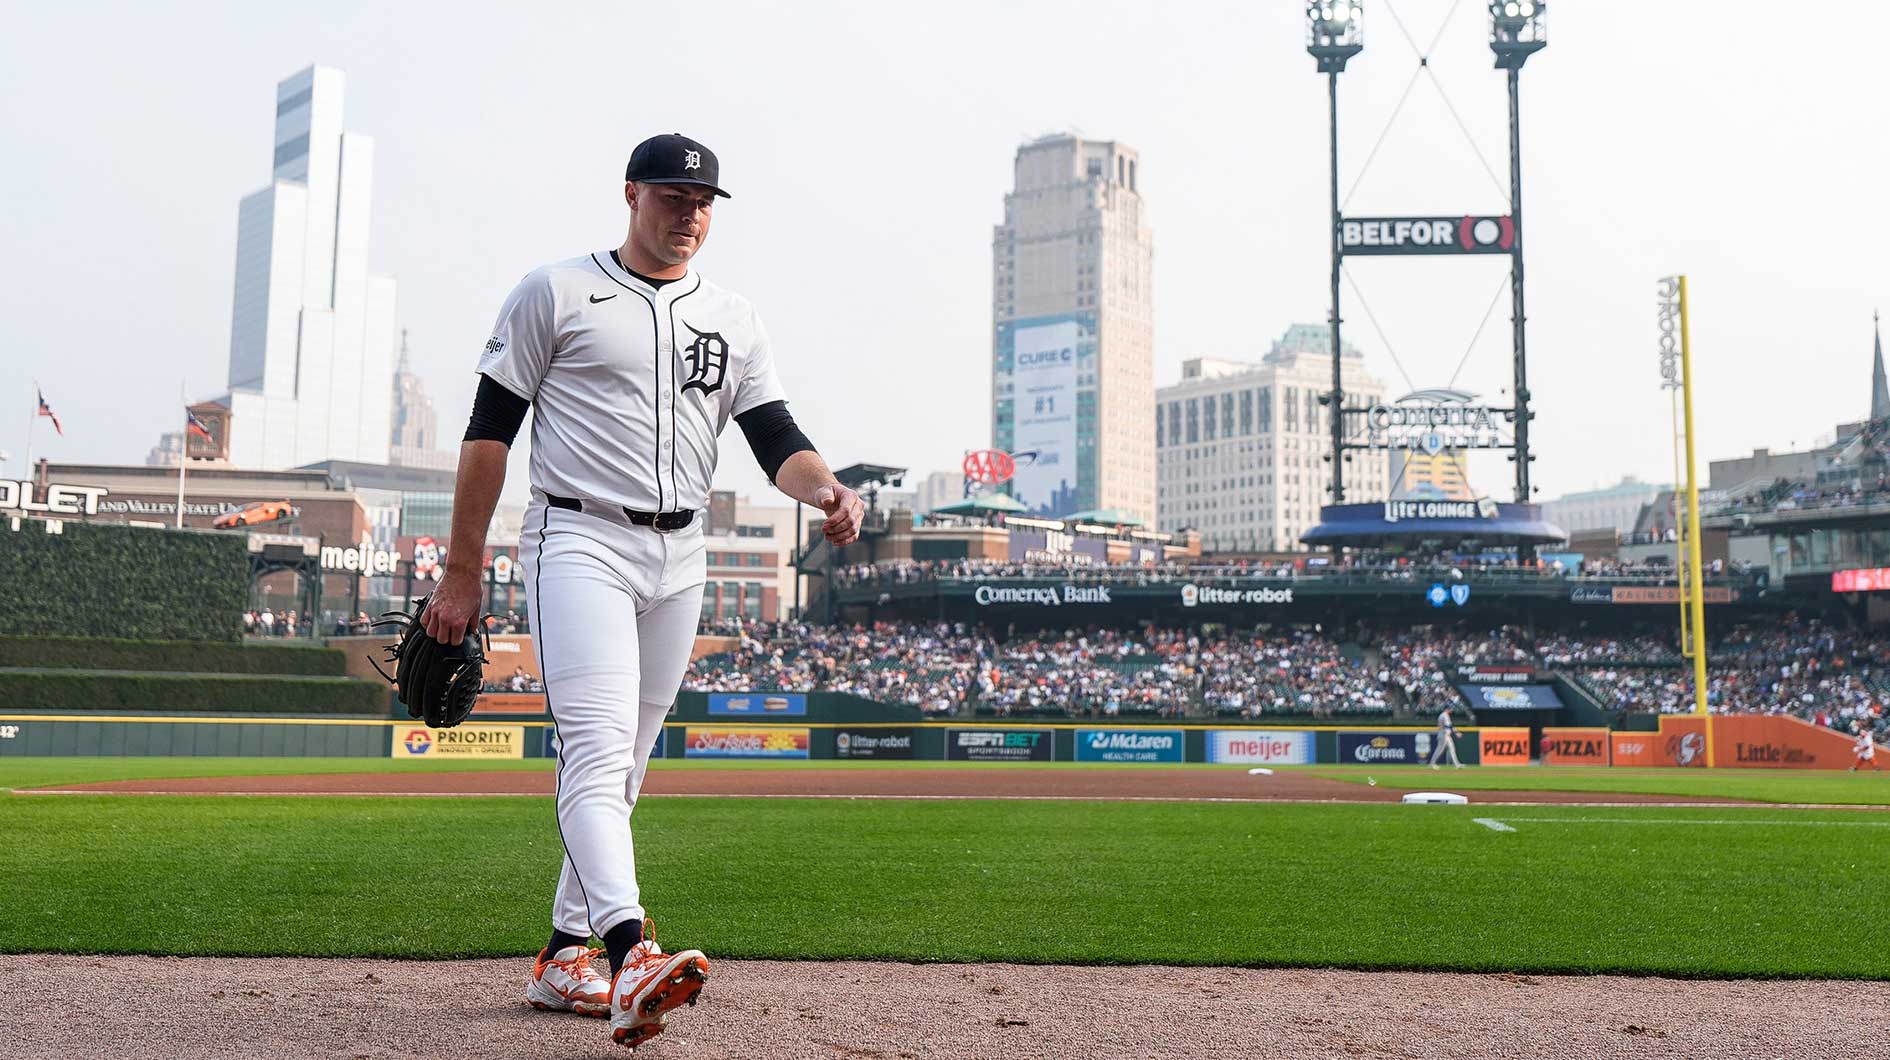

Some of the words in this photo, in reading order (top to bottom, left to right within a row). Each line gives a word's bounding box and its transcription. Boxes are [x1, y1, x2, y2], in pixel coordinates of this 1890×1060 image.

[685, 149, 701, 170] D
[1343, 221, 1453, 246] BELFOR
[681, 319, 729, 398] D
[1418, 502, 1475, 519] LOUNGE
[320, 544, 401, 577] meijer
[1064, 585, 1111, 603] Bank
[437, 731, 512, 743] PRIORITY
[958, 732, 1004, 746] ESPN
[1004, 732, 1041, 747] BET
[1110, 733, 1173, 749] McLaren
[1228, 736, 1292, 760] meijer
[1354, 744, 1406, 762] Corona
[1483, 740, 1527, 756] PIZZA!
[1736, 743, 1780, 763] Little
